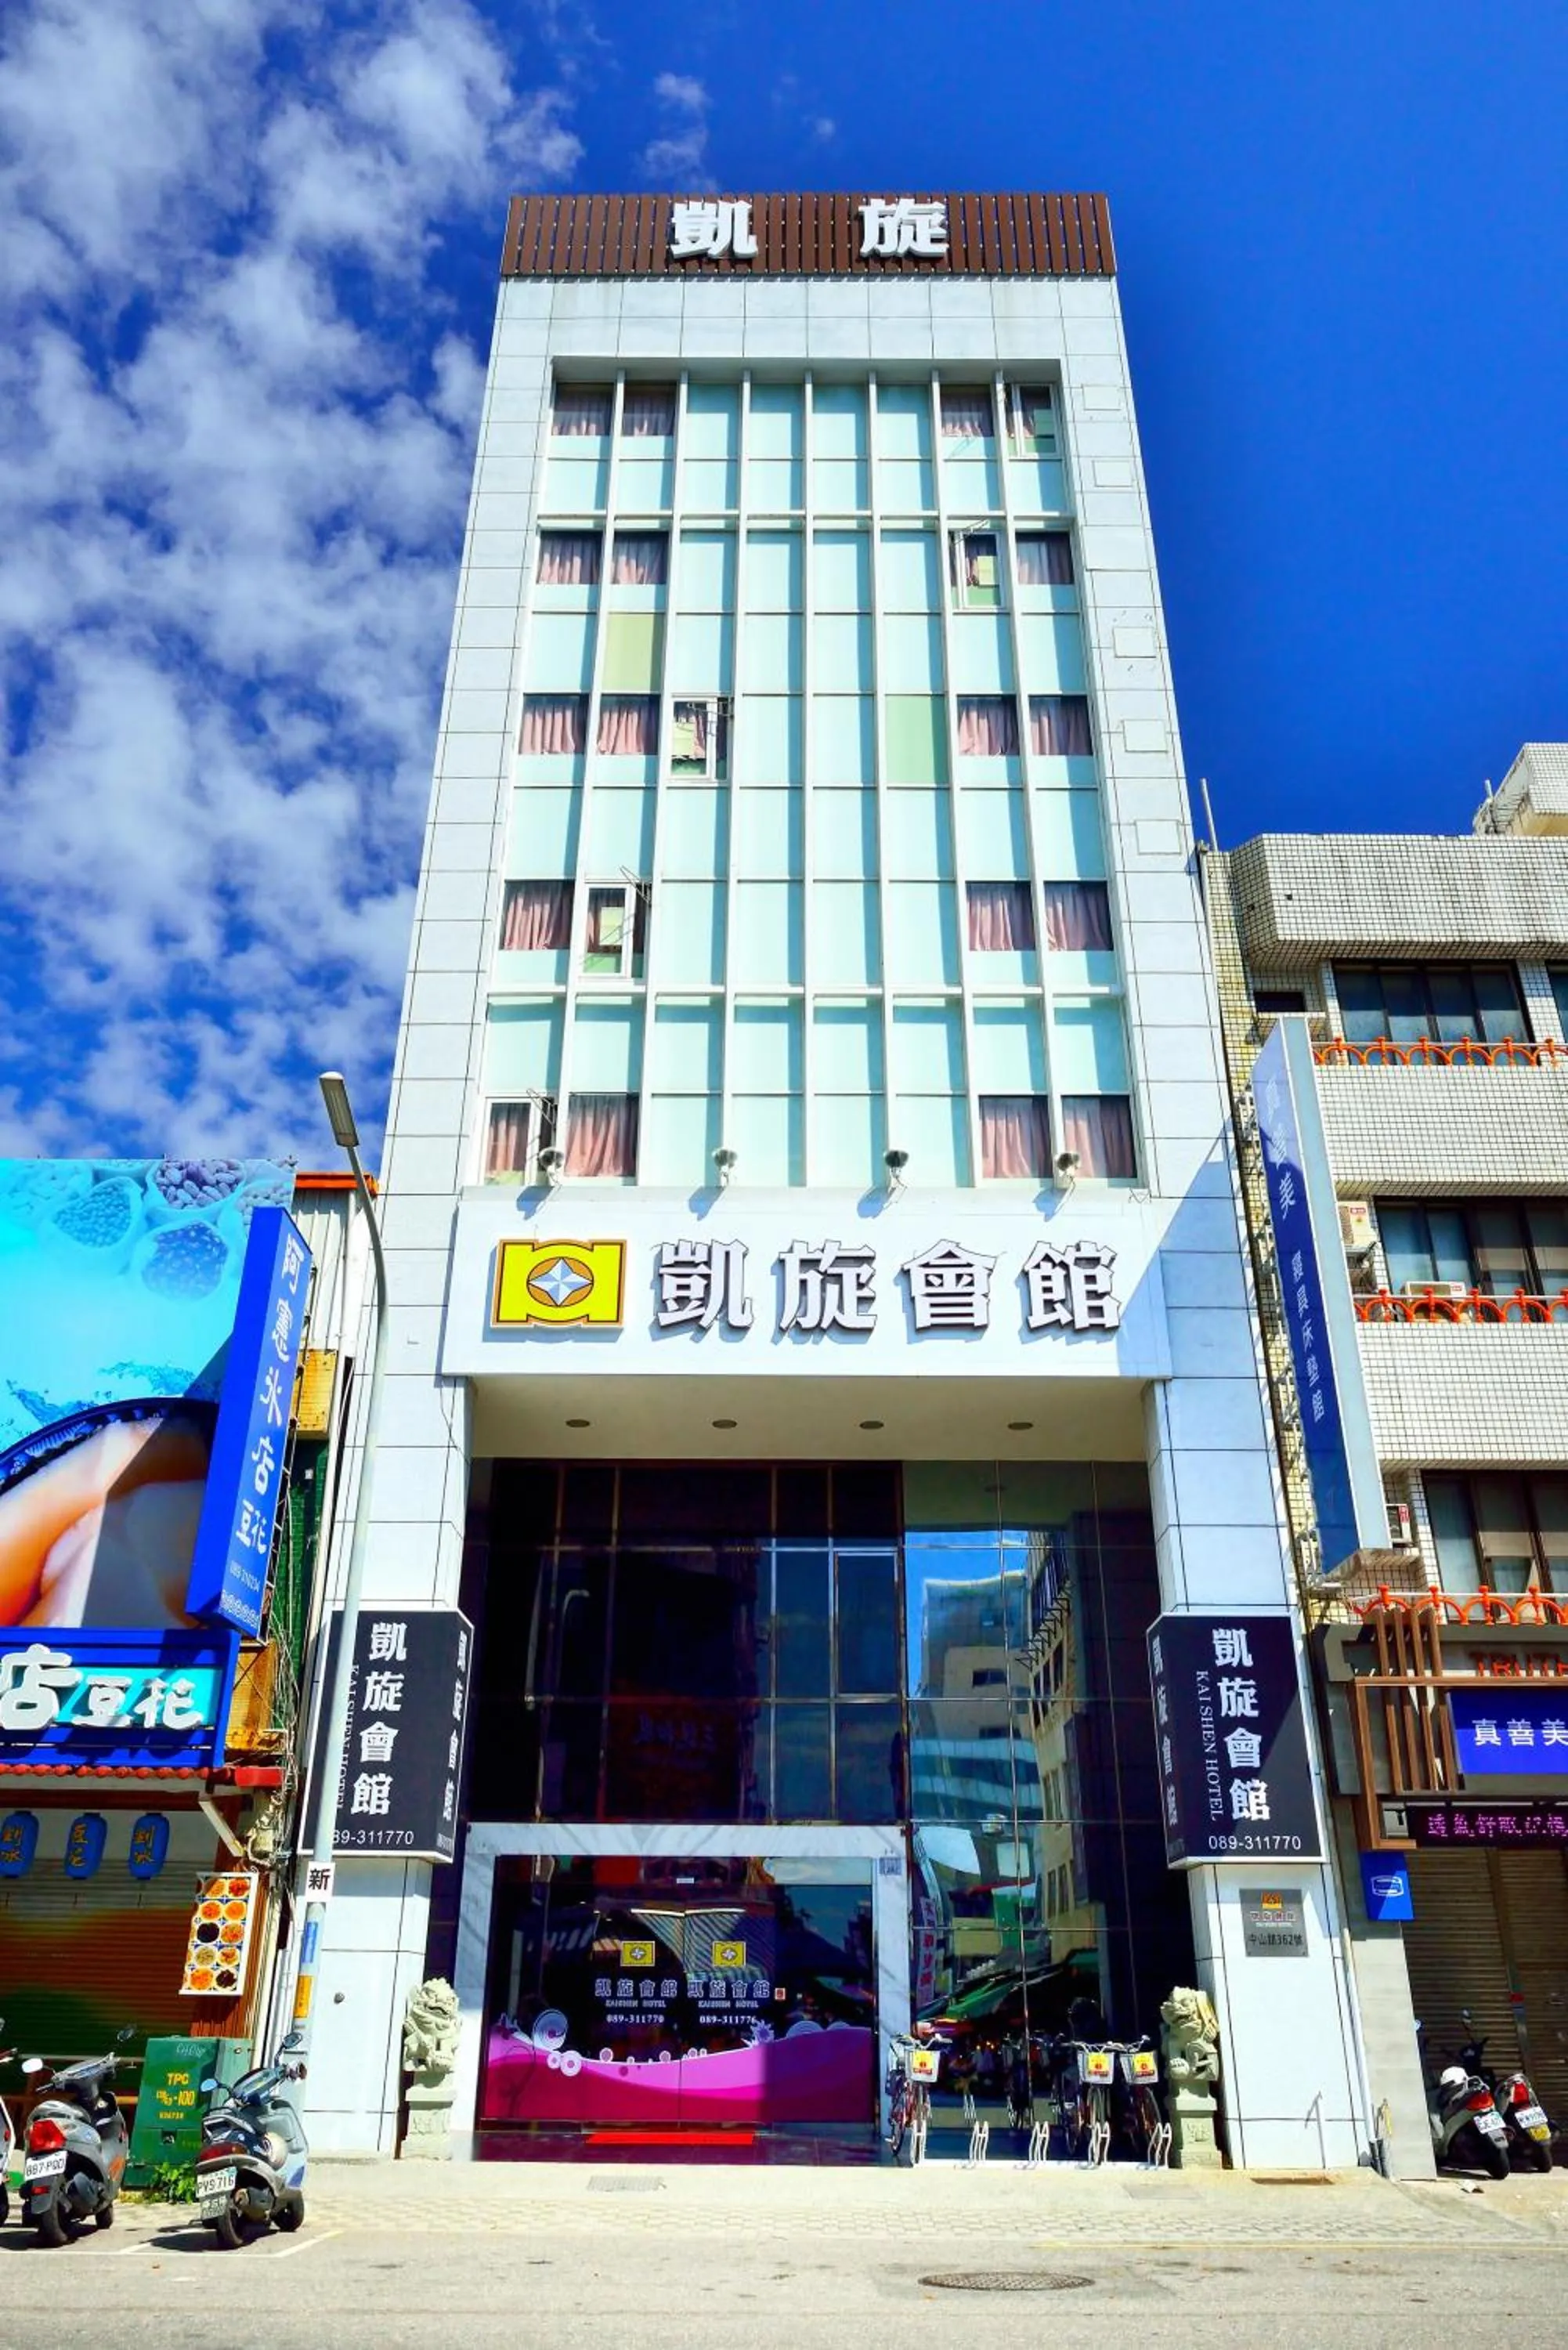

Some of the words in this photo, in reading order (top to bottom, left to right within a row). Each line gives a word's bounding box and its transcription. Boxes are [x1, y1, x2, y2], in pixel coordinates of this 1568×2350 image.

[670, 198, 950, 259] 凱旋
[657, 1238, 1122, 1332] 凱旋會館
[350, 1622, 408, 1816] 凱旋會館
[1212, 1629, 1270, 1821] 凱旋會館
[1472, 1719, 1568, 1747] 真善美
[1205, 1759, 1224, 1821] HOTEL
[332, 1829, 414, 1845] 89-311770
[1209, 1835, 1301, 1850] 089-311770
[308, 1867, 331, 1890] 新
